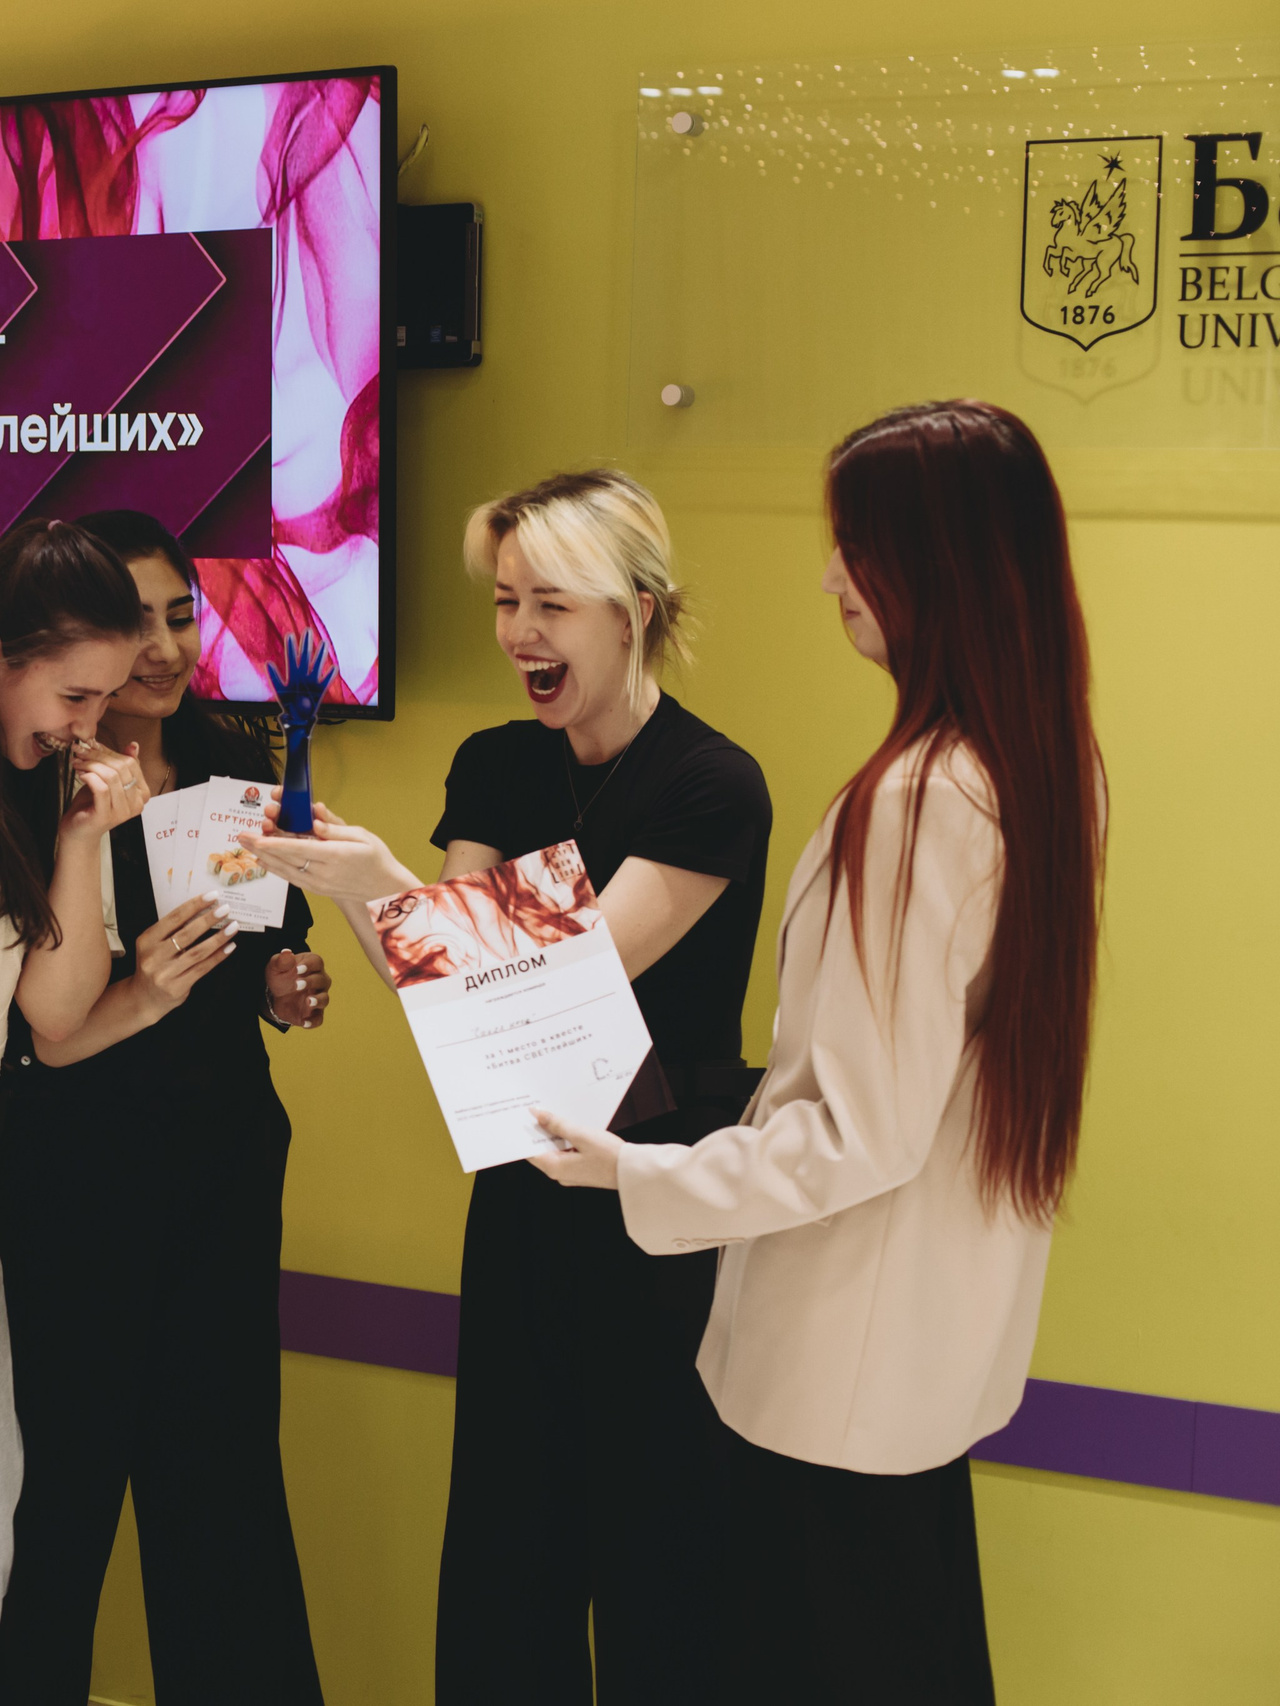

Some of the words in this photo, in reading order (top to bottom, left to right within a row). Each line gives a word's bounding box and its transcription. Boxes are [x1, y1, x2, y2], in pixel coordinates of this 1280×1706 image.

[1180, 132, 1280, 241] Б
[1060, 305, 1116, 325] 1876
[210, 812, 262, 829] СЕРТИФИ
[464, 954, 547, 992] ДИПЛОМ
[507, 1040, 538, 1054] место
[550, 1024, 584, 1041] квесте
